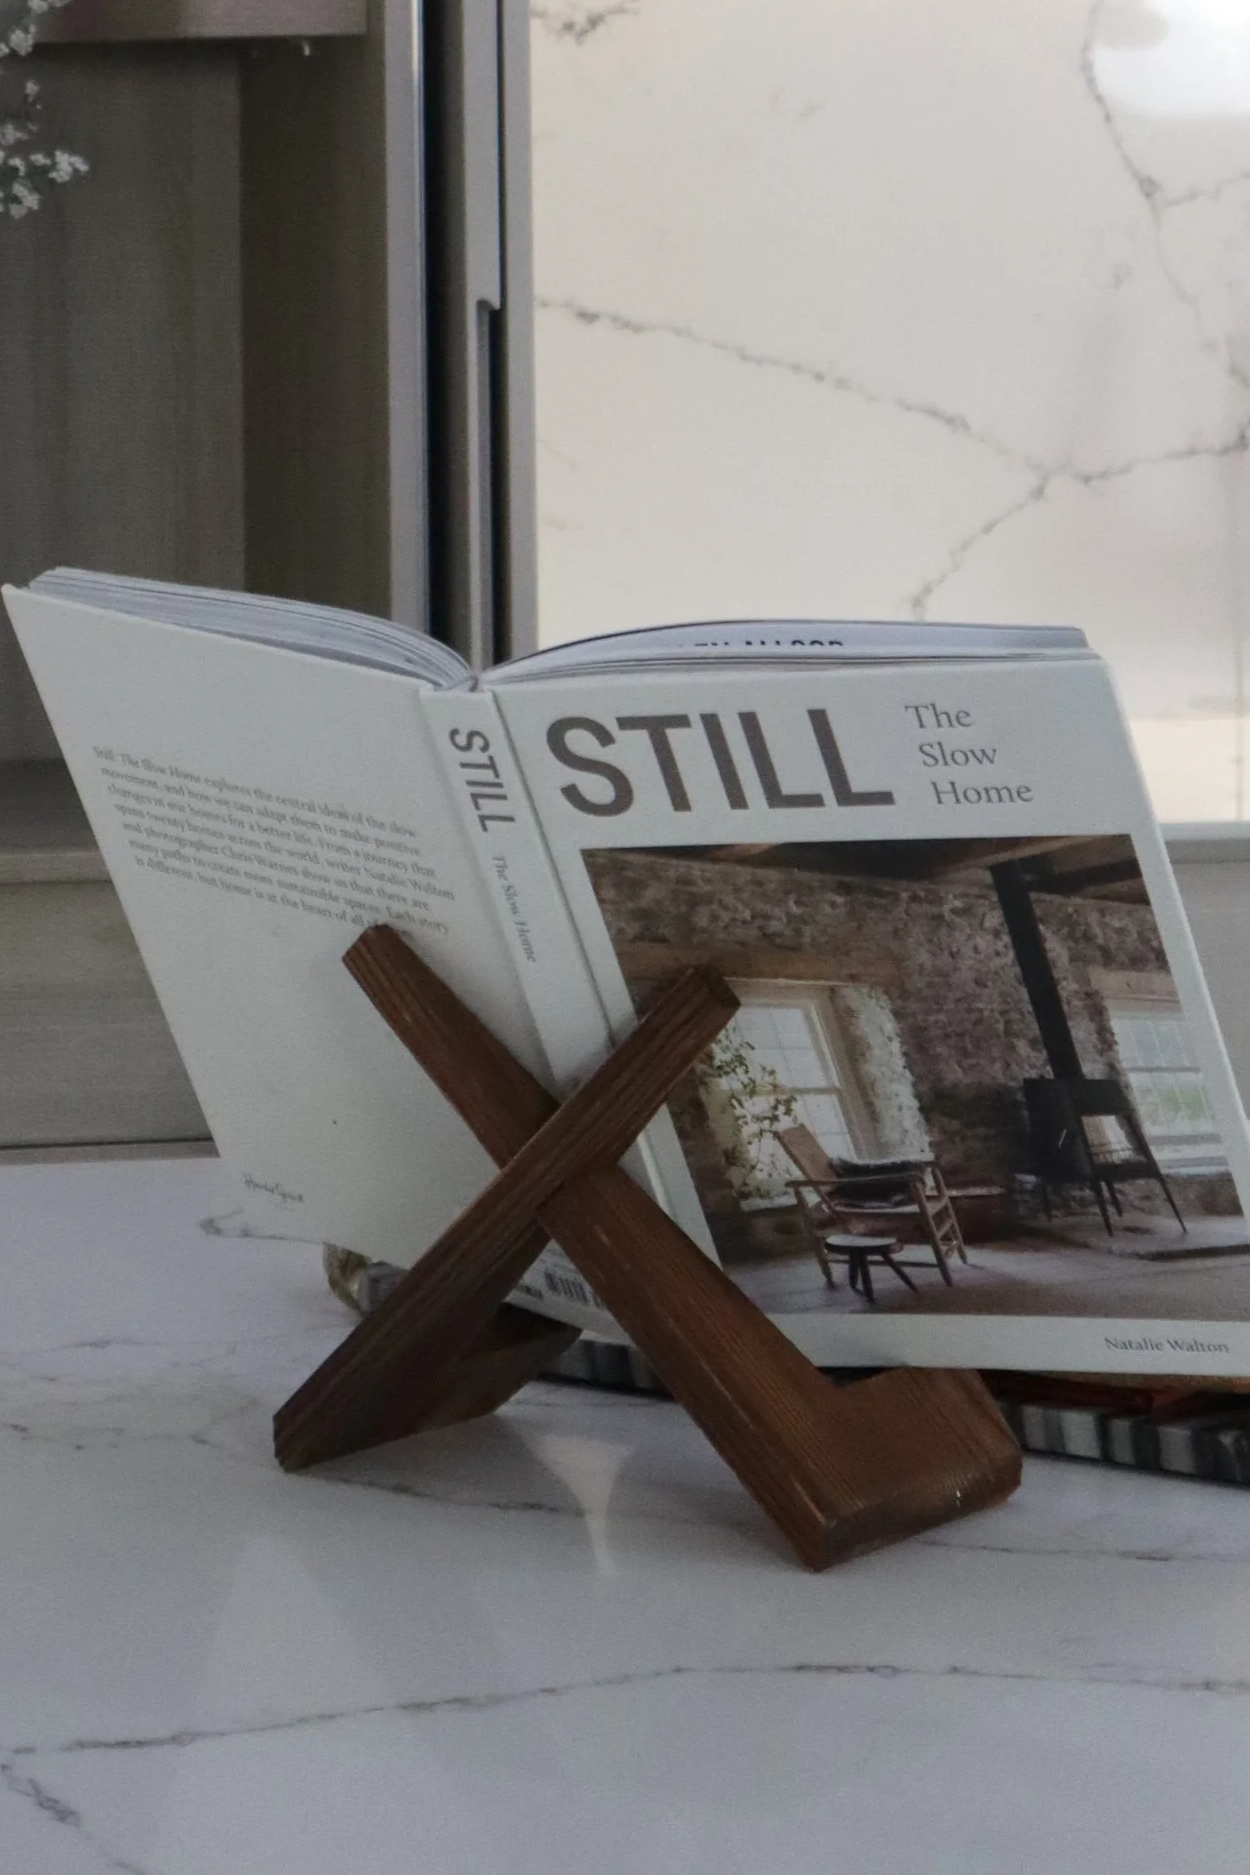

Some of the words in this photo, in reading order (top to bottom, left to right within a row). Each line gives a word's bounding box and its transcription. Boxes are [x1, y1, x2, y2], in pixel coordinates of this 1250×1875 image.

[905, 703, 971, 728] The
[545, 707, 895, 817] STILL
[919, 741, 997, 767] Slow
[931, 779, 1034, 805] Home
[449, 727, 515, 833] STILL
[492, 855, 507, 882] The
[502, 884, 521, 916] Slow
[514, 916, 537, 963] Home
[1104, 1336, 1164, 1352] Natalie
[1167, 1338, 1229, 1354] Walton
